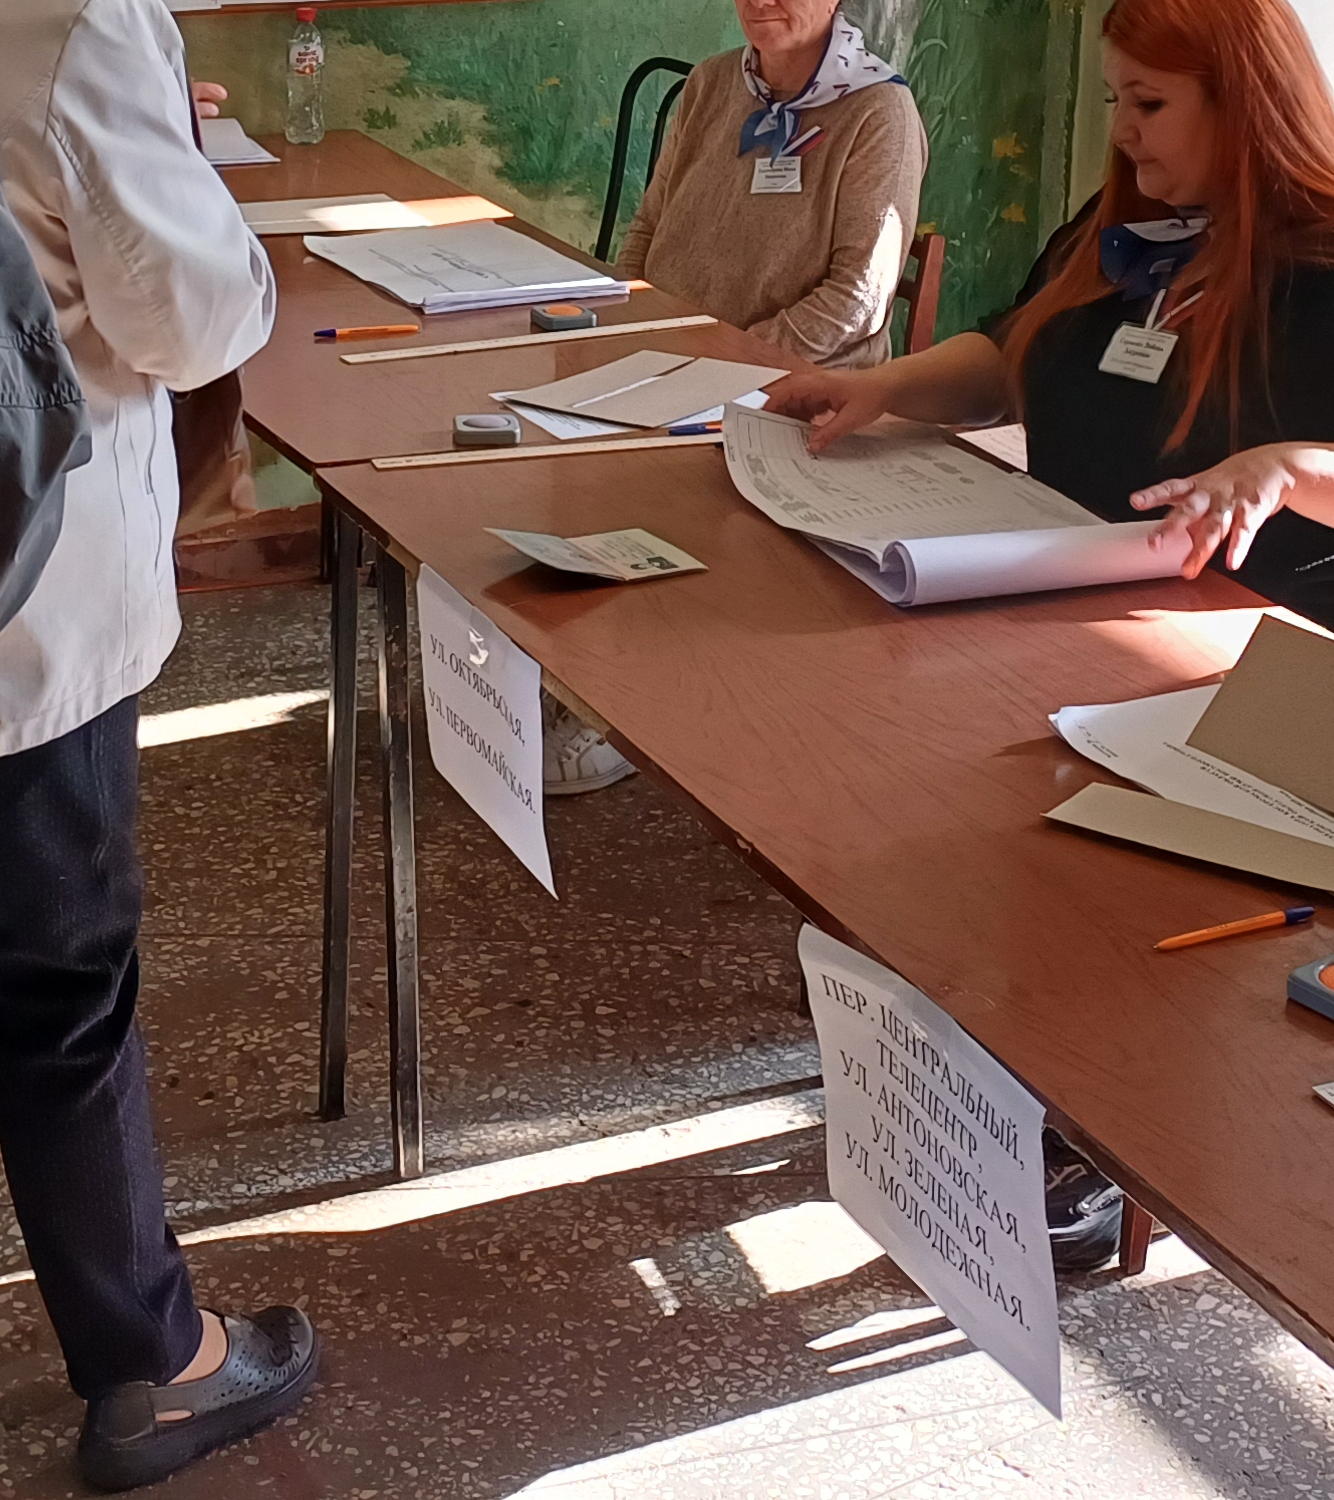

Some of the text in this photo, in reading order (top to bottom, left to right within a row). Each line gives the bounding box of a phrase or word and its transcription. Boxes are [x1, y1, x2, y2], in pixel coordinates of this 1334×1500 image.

[429, 633, 448, 666] УЛ.
[428, 686, 536, 814] УЛ. ПЕРВОМАЙСКАЯ.
[839, 1048, 1027, 1254] УЛ. АНТОНОВСКАЯ,
[878, 1002, 1026, 1171] ЦЕНТРАЛЬНЫЙ,
[844, 1130, 1032, 1332] УЛ. МОЛОДЕЖНАЯ.
[870, 1113, 996, 1266] УЛ. ЗЕЛЕНАЯ,
